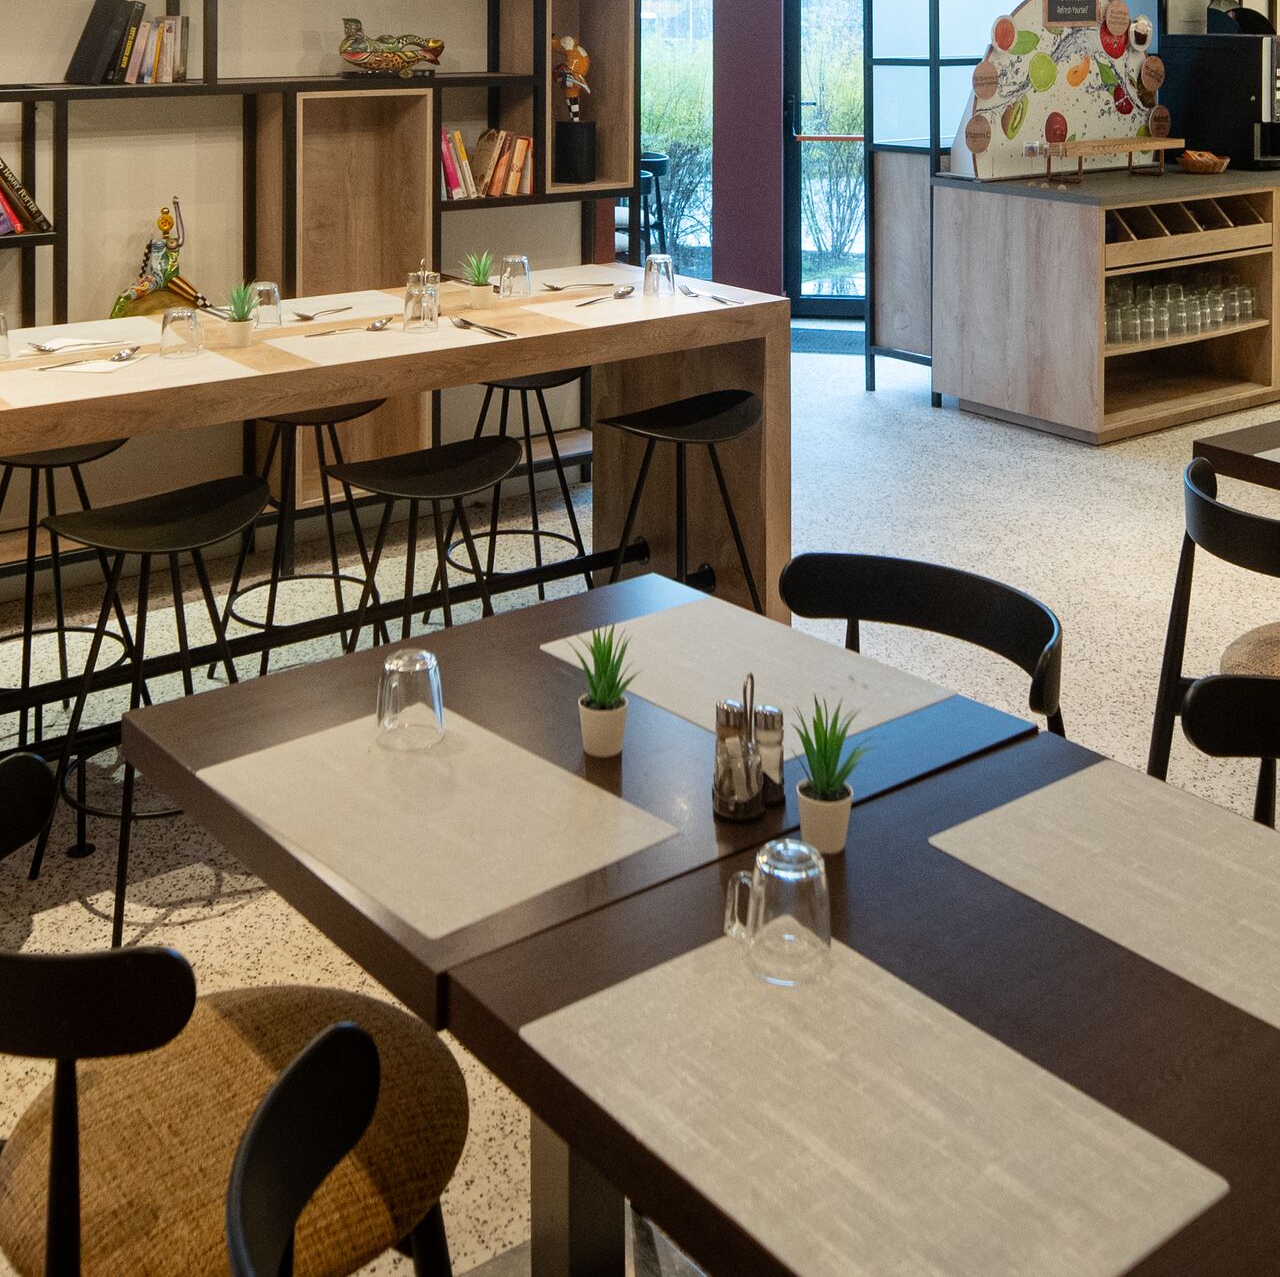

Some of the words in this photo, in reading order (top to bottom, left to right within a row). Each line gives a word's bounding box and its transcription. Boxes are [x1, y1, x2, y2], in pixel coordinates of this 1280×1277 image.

[1056, 5, 1071, 14] Refresh
[3, 167, 21, 189] HARRY
[18, 188, 38, 213] POTTER
